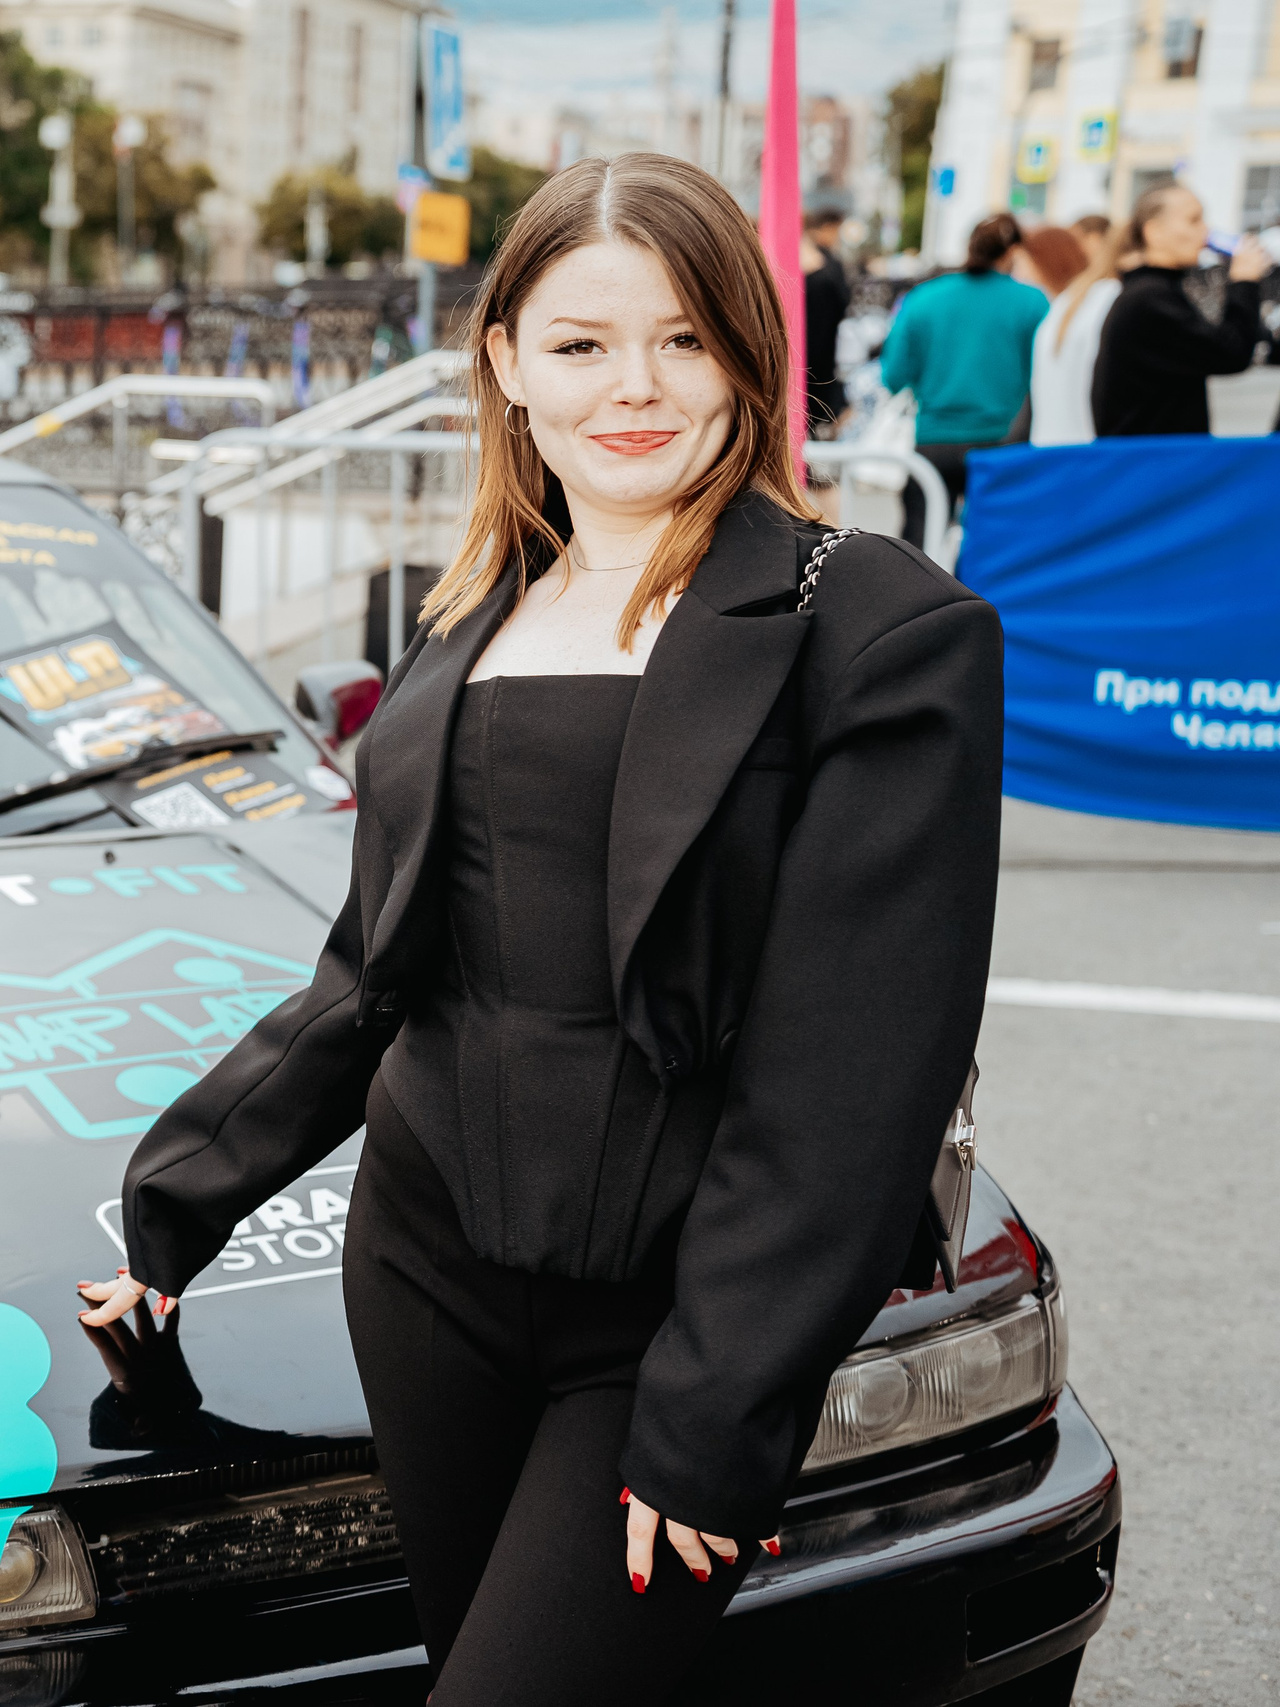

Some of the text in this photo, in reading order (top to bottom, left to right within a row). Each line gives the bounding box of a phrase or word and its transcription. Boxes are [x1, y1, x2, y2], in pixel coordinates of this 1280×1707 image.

[1095, 670, 1181, 713] При
[1172, 712, 1280, 749] Челя
[94, 863, 248, 898] FIT
